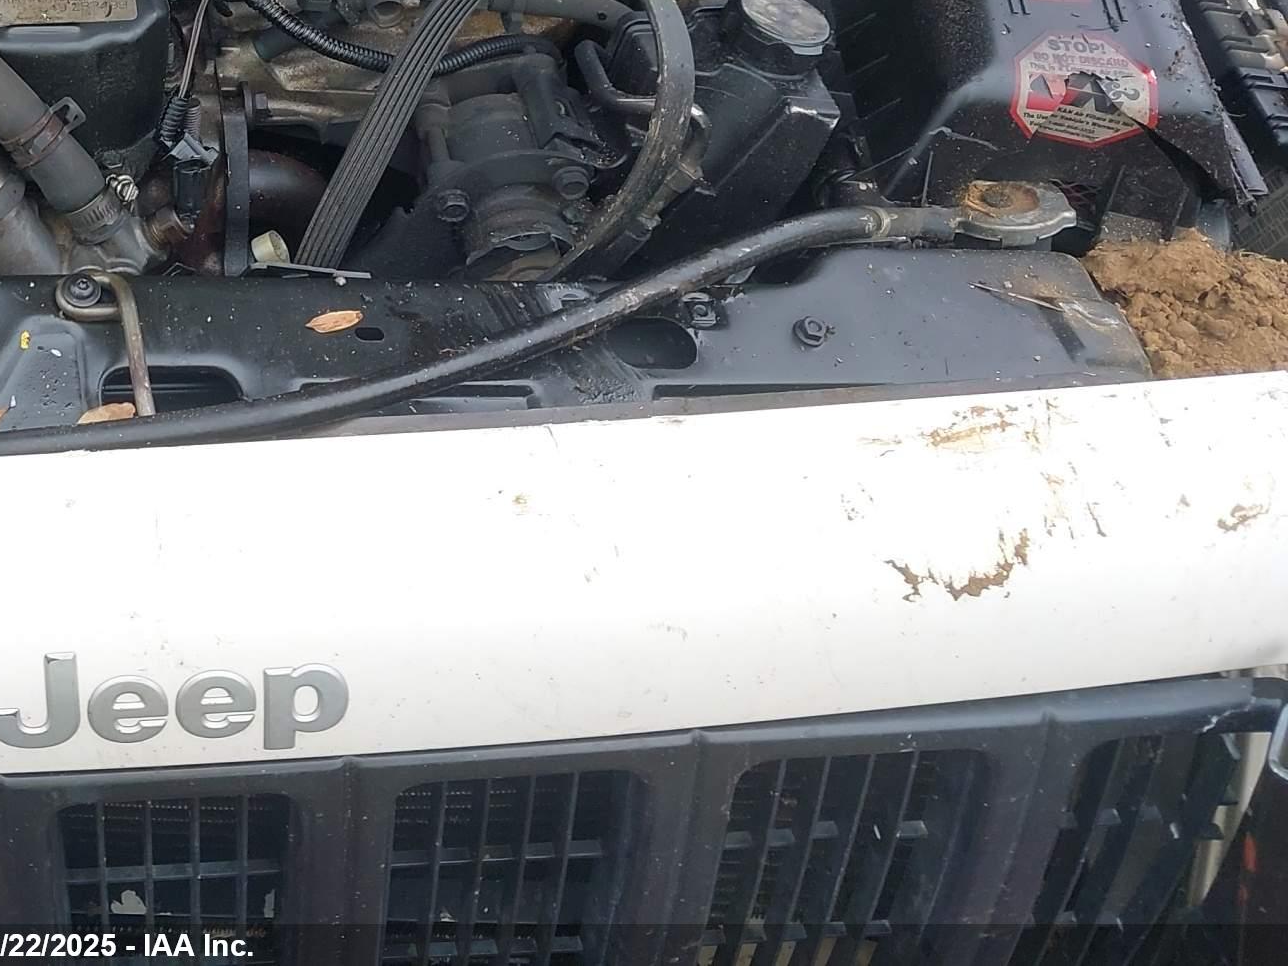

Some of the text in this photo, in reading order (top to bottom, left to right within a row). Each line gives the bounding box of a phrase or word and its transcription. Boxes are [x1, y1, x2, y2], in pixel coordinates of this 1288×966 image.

[1048, 39, 1106, 54] STOP!
[1033, 52, 1129, 68] DO NOT DISCARD
